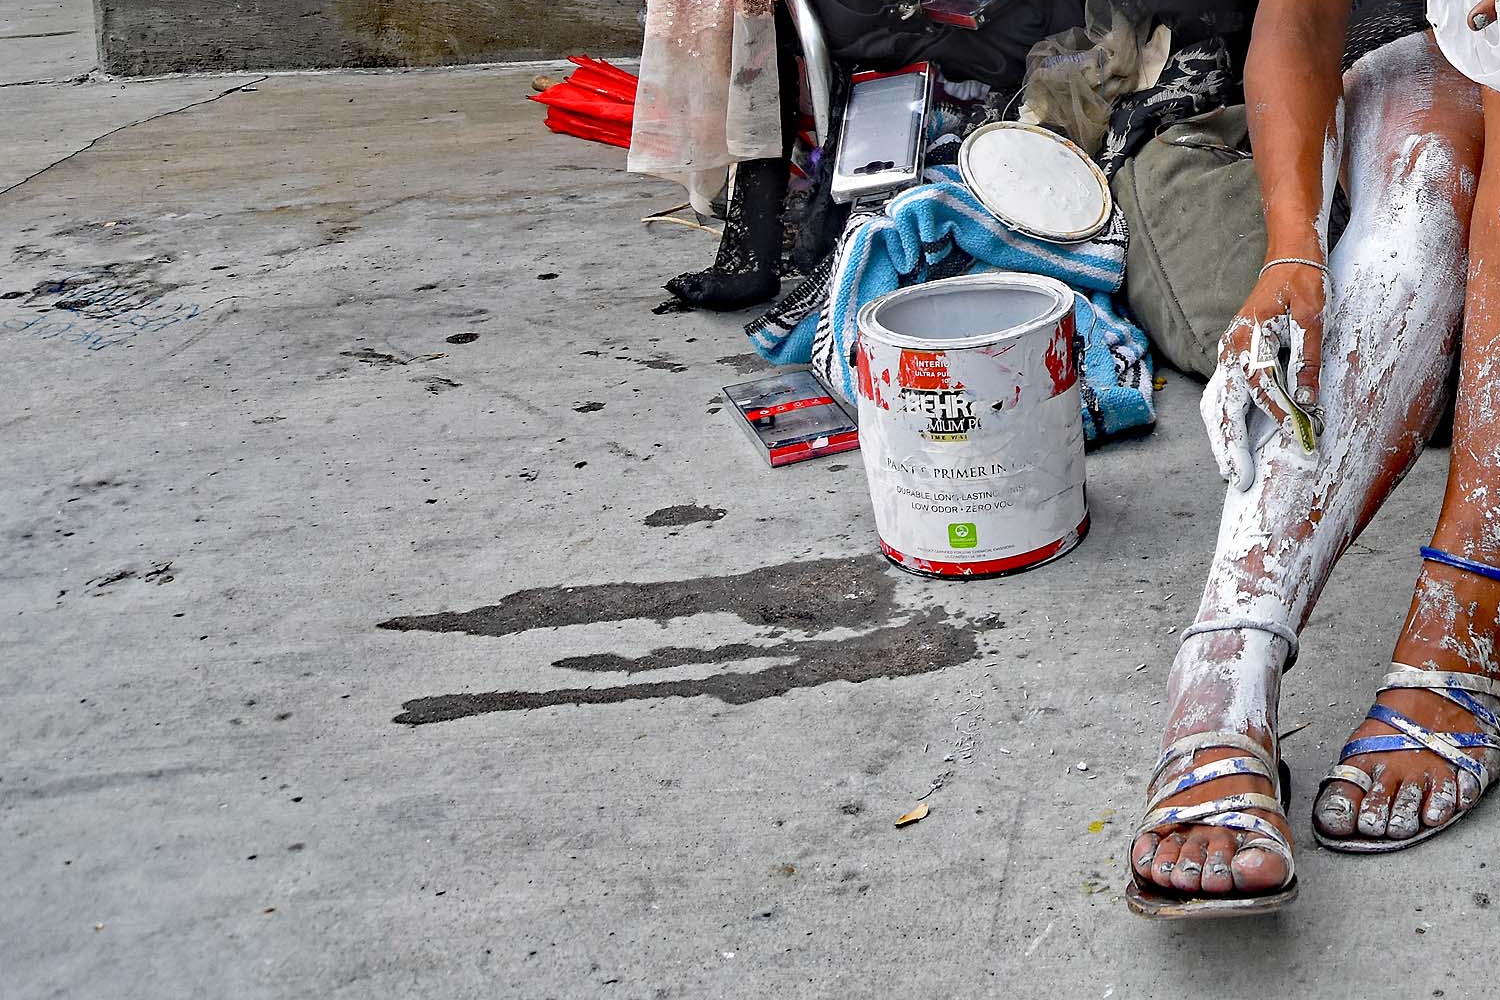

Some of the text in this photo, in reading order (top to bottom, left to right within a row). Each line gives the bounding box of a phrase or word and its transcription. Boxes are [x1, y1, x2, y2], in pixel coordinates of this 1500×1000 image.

[888, 457, 915, 474] PANT
[933, 466, 988, 479] PRIMER
[991, 463, 1007, 475] IN
[911, 501, 930, 511] LOW
[930, 504, 959, 513] ODOR
[966, 503, 992, 513] ZERO
